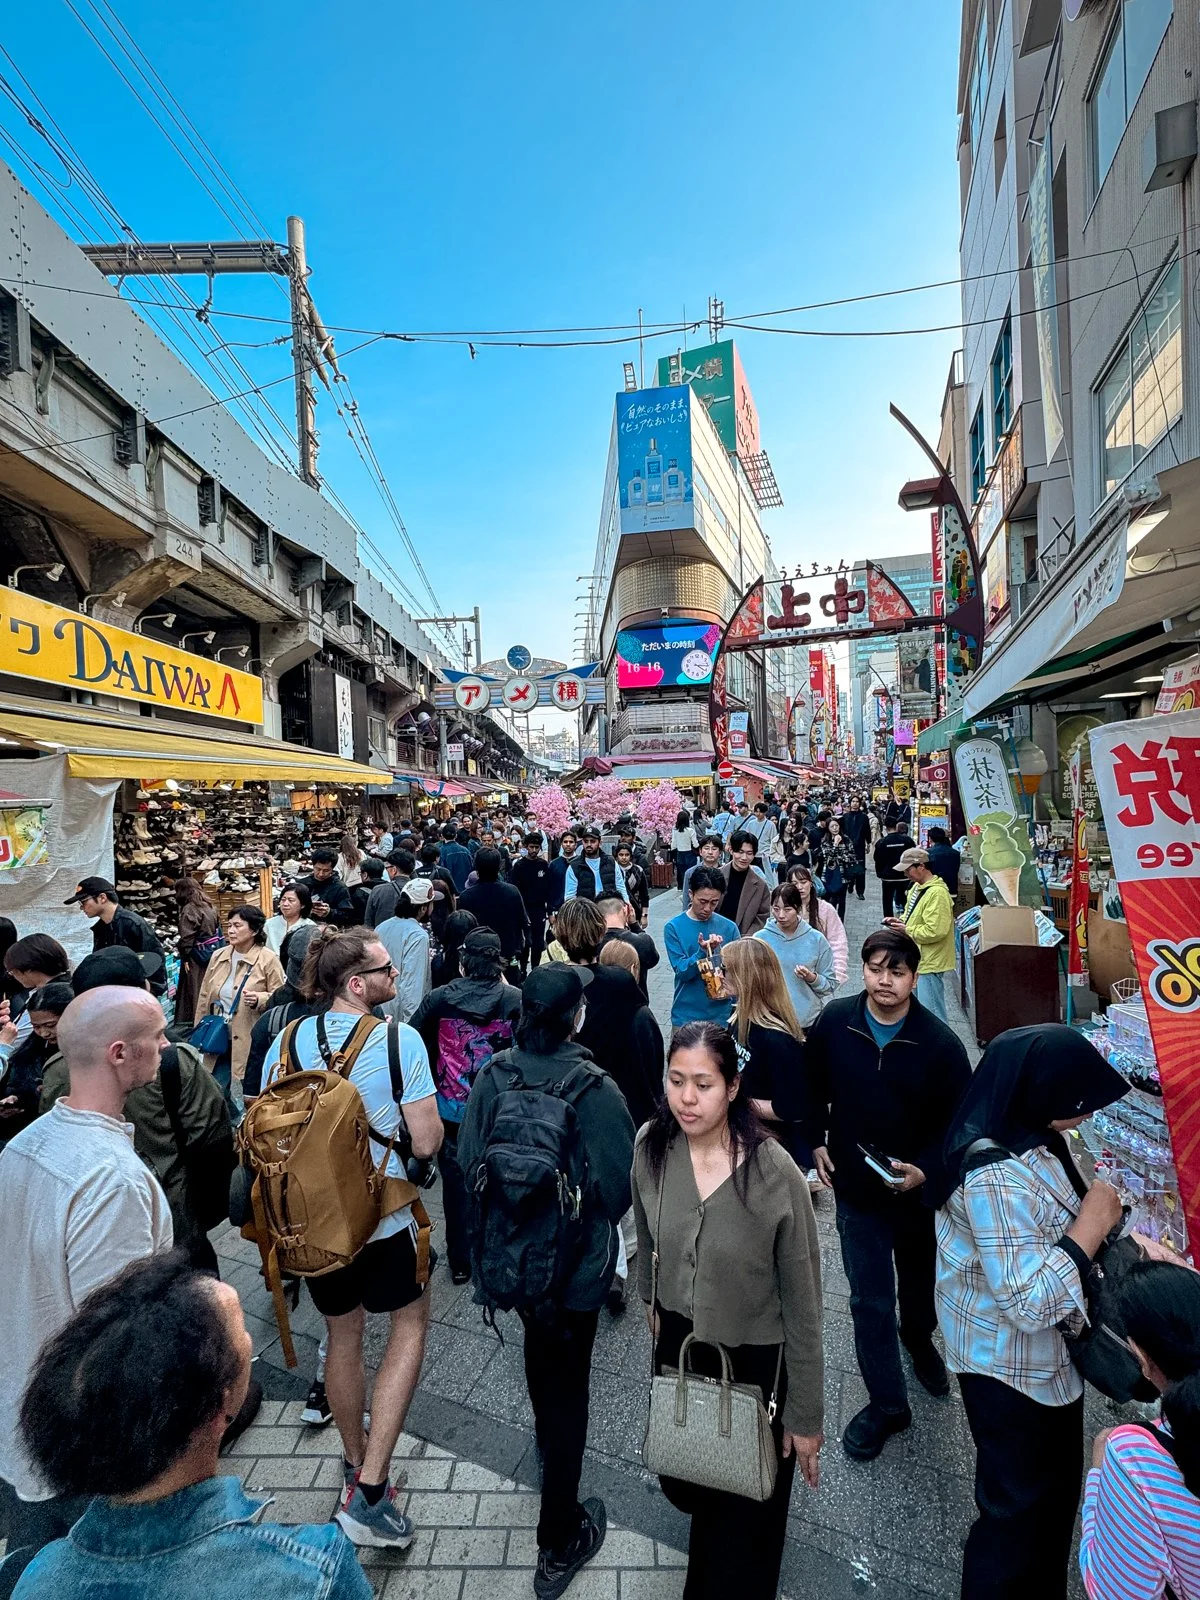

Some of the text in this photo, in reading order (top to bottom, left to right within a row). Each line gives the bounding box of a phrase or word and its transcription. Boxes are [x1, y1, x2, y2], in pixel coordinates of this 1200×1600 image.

[672, 358, 722, 383] メ横
[175, 539, 193, 560] 244
[780, 559, 849, 579] うえちゅん
[767, 578, 866, 630] 上中
[641, 640, 695, 651] ただいまの時刻
[900, 640, 925, 648] MASTERS
[54, 618, 211, 709] DAIWA
[627, 662, 660, 673] 16 16
[460, 681, 579, 706] アメ横
[631, 738, 700, 750] アメ横センター
